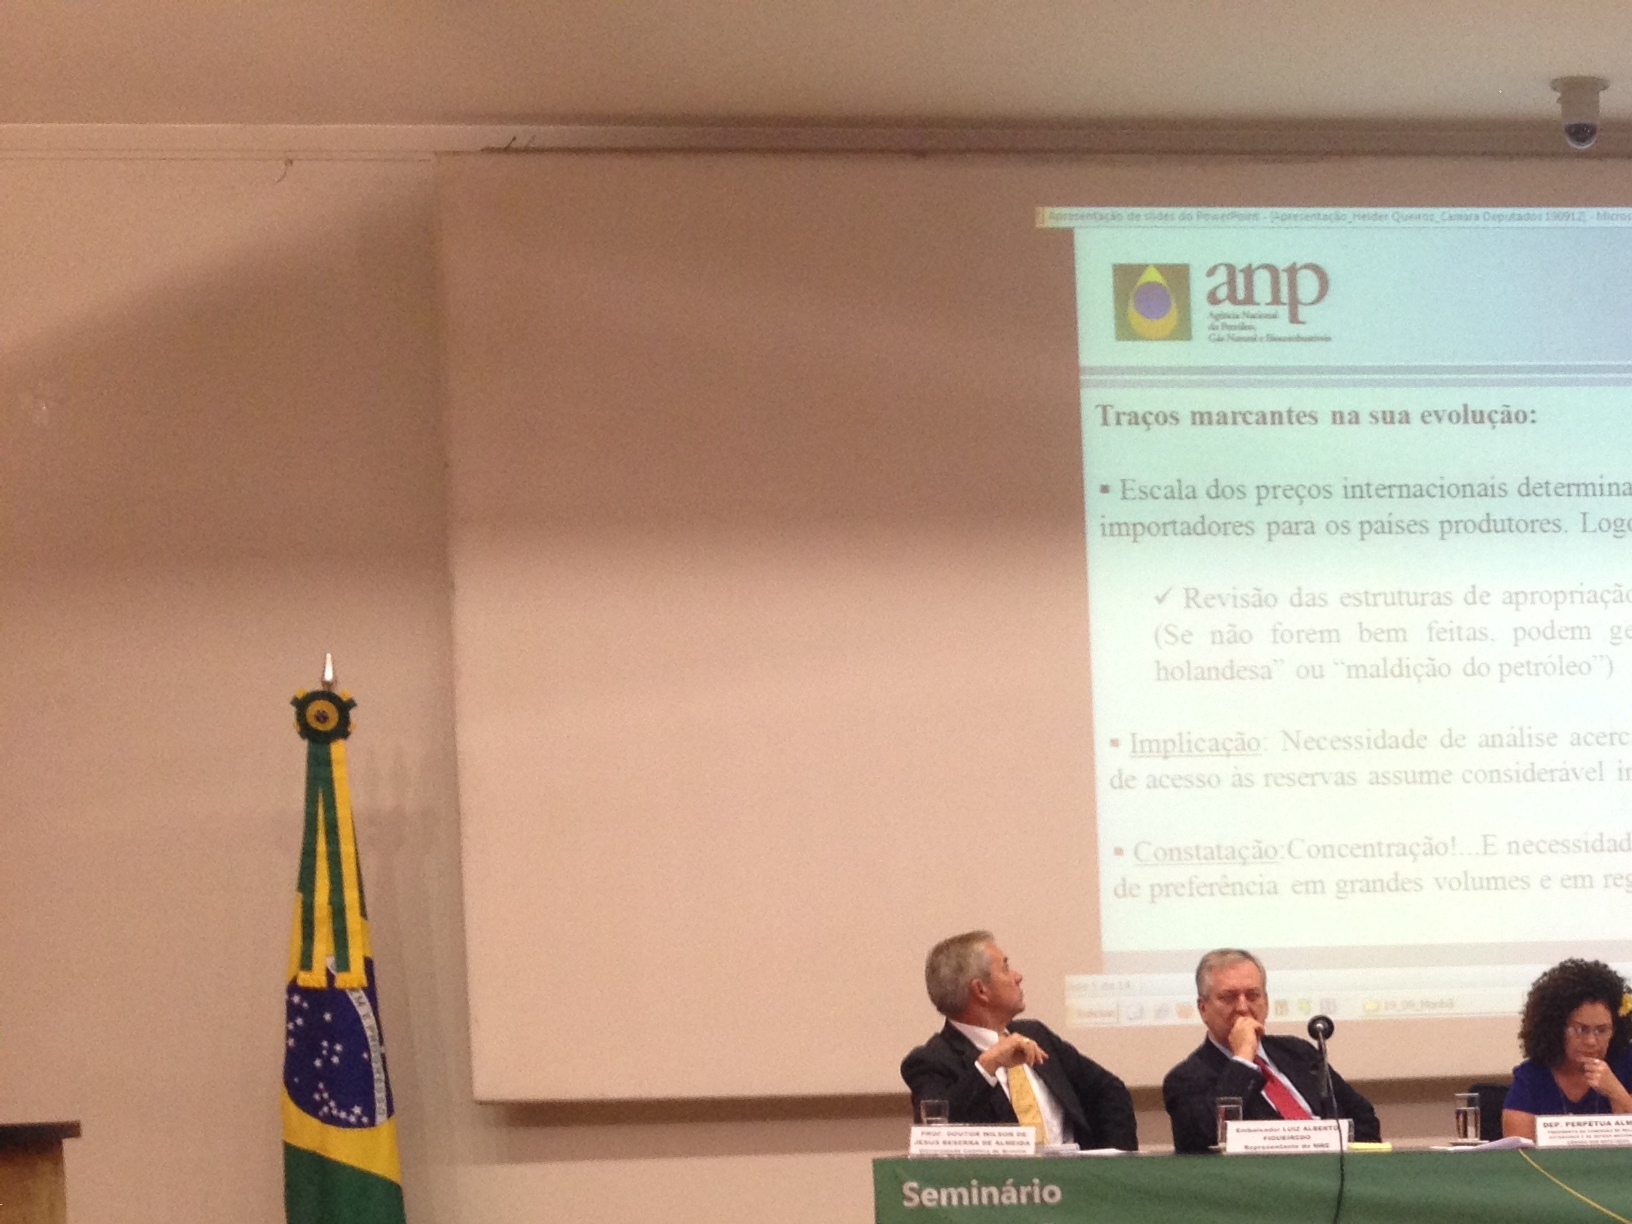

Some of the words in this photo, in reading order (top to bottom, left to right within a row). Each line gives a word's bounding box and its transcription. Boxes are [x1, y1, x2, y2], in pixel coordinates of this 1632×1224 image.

[1206, 262, 1329, 325] anp
[1095, 404, 1180, 431] Traços
[1190, 407, 1318, 426] marcantes
[1331, 410, 1360, 425] na
[1369, 410, 1411, 425] sua
[1420, 403, 1537, 429] evolução:
[1120, 478, 1198, 501] Escala
[1205, 478, 1247, 500] dos
[1255, 483, 1333, 507] preços
[1342, 476, 1508, 500] internacionais
[1100, 514, 1255, 544] importadores
[1266, 520, 1316, 542] para
[1325, 520, 1351, 536] os
[1358, 512, 1430, 542] países
[1439, 512, 1568, 541] produtores.
[1183, 586, 1278, 609] Revisão
[1289, 586, 1328, 608] das
[1339, 589, 1454, 608] estruturas
[1463, 584, 1491, 606] de
[1210, 623, 1254, 645] não
[1271, 621, 1341, 645] forem
[1357, 621, 1408, 643] bem
[1513, 619, 1592, 647] podem
[1296, 664, 1325, 679] ou
[1462, 656, 1491, 678] do
[1281, 728, 1428, 752] Necessidade
[1440, 727, 1466, 749] de
[1478, 725, 1558, 749] análise
[1109, 768, 1137, 790] de
[1146, 774, 1222, 790] acesso
[1231, 766, 1255, 788] às
[1263, 771, 1358, 788] reservas
[1368, 769, 1453, 786] assume
[1462, 760, 1604, 785] considerável
[1113, 876, 1141, 899] de
[1149, 874, 1279, 904] preferência
[1291, 879, 1326, 895] em
[1335, 871, 1424, 900] grandes
[1434, 870, 1531, 892] volumes
[1540, 875, 1552, 890] e
[1560, 874, 1595, 889] em
[902, 1178, 1062, 1208] Seminário
